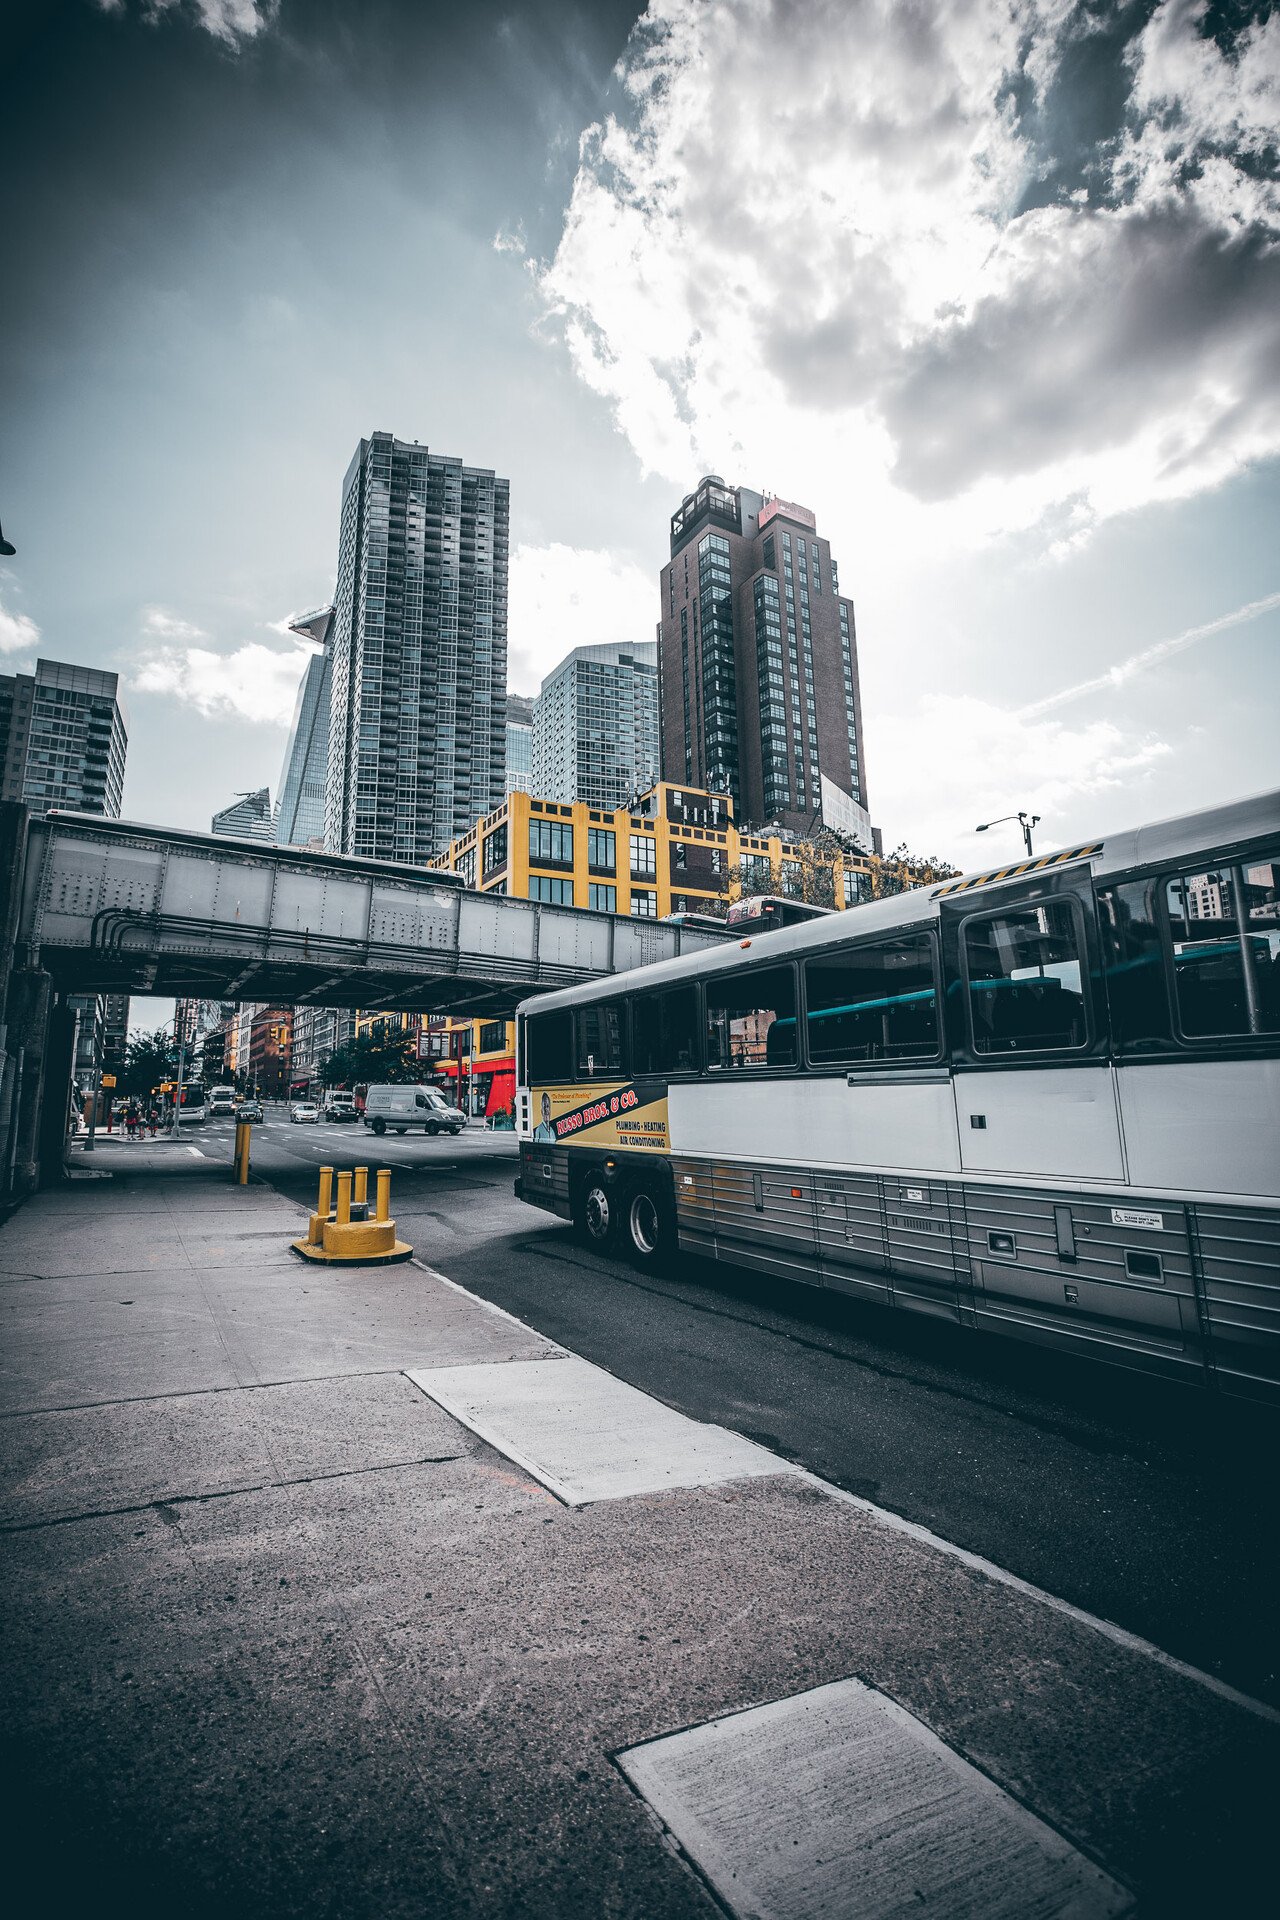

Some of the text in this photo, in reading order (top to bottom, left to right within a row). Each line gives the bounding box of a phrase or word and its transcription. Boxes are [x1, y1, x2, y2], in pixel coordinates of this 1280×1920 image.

[556, 1090, 639, 1135] RUSSO BROS. & CO.
[615, 1120, 640, 1131] PLUMBING
[643, 1121, 666, 1132] HEATING
[620, 1136, 665, 1148] AIR CONDITIONING
